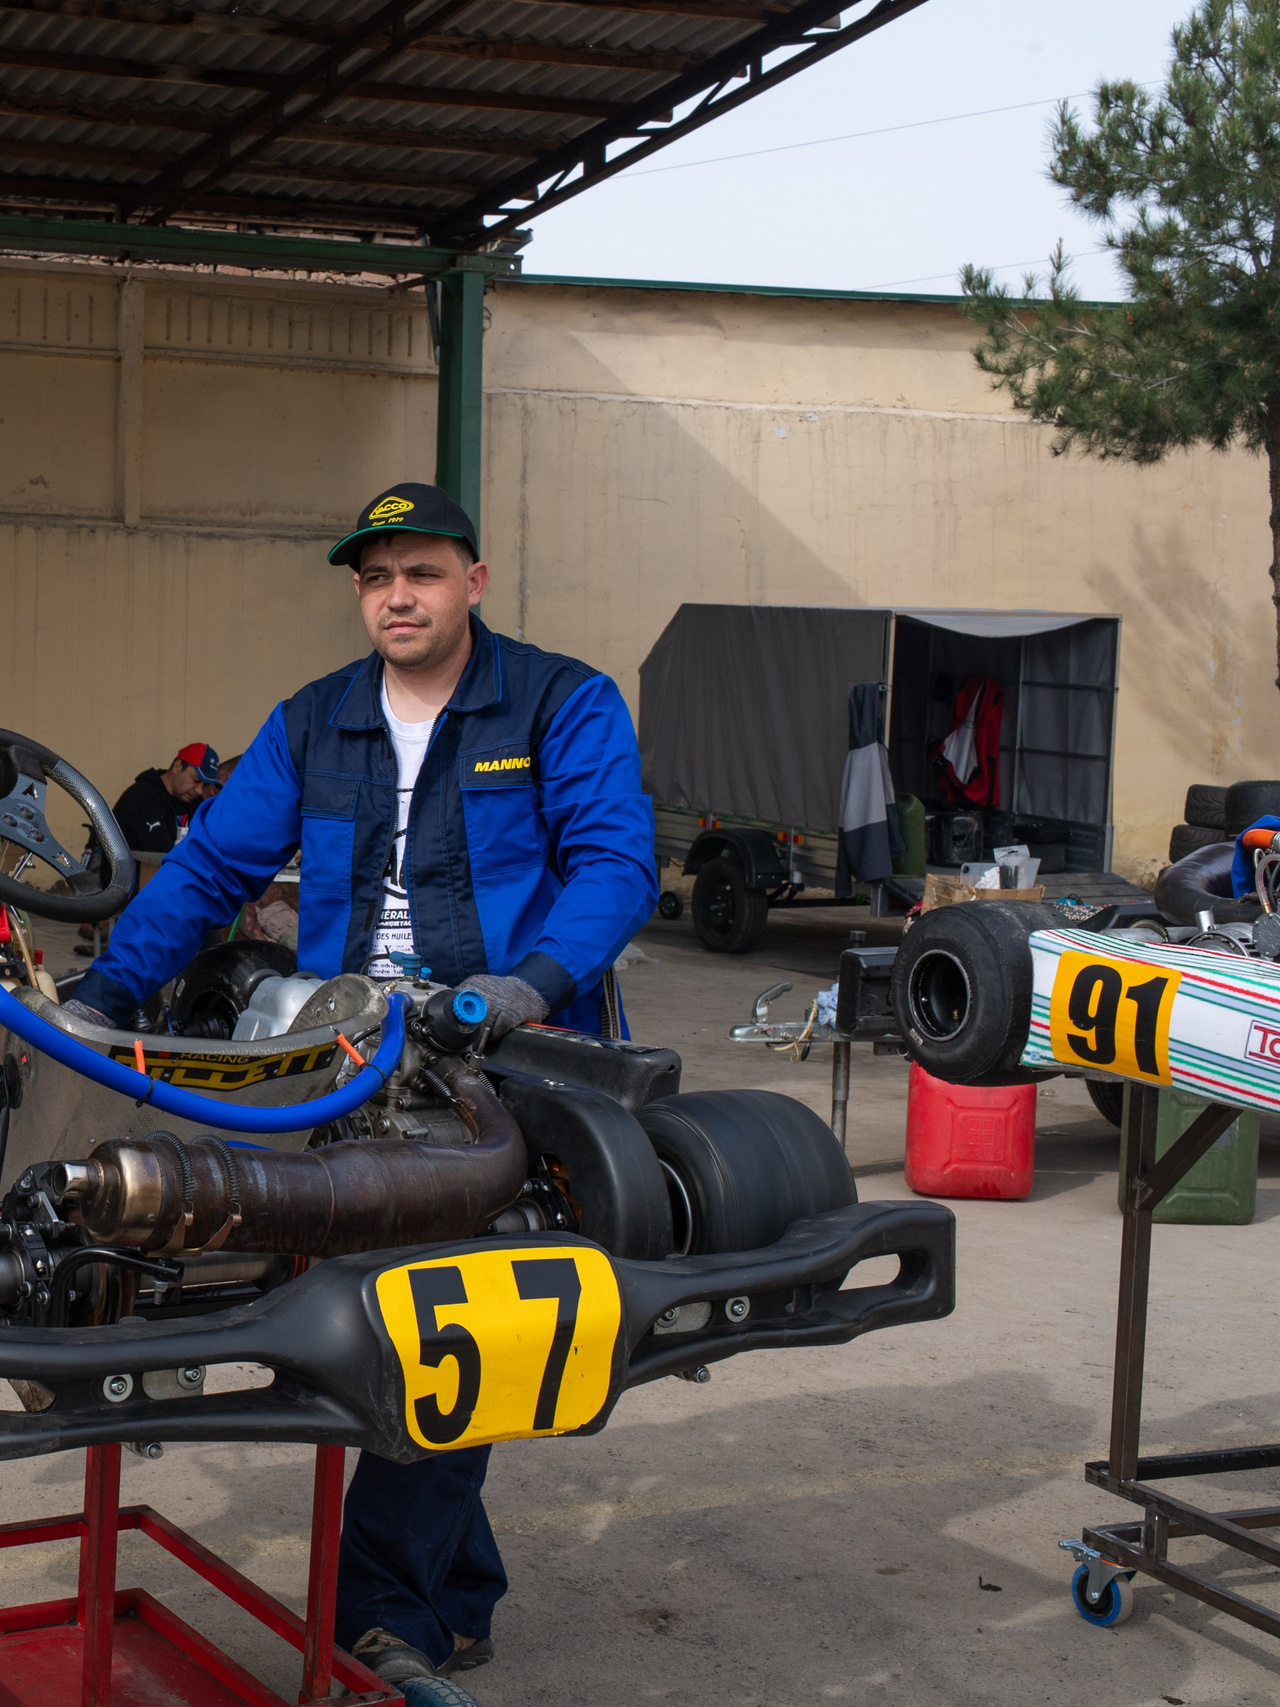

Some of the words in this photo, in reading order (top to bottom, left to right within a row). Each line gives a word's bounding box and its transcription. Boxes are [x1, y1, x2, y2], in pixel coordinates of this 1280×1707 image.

[375, 503, 408, 515] YACCO
[381, 909, 411, 920] ÉRAL
[1066, 964, 1169, 1076] 91
[180, 1051, 250, 1064] RACING
[407, 1257, 582, 1445] 57
